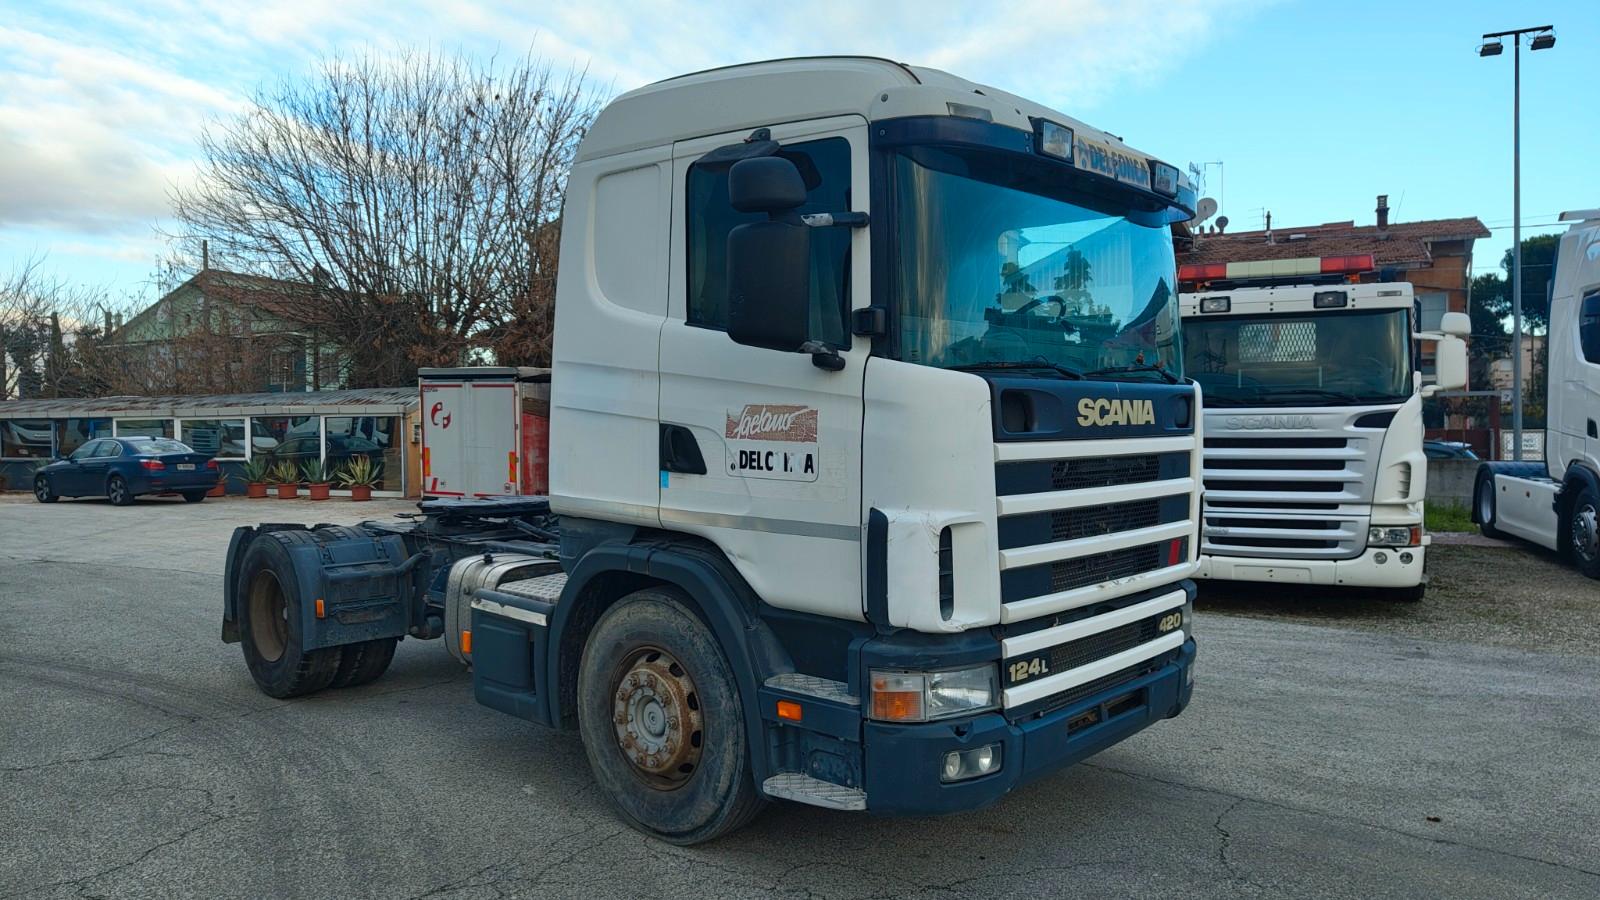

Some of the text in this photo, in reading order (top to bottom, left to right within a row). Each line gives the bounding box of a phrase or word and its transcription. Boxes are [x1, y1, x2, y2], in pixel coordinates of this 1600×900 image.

[1077, 398, 1155, 426] SCANIA
[1225, 416, 1318, 430] SCANIA
[1159, 612, 1182, 632] 420
